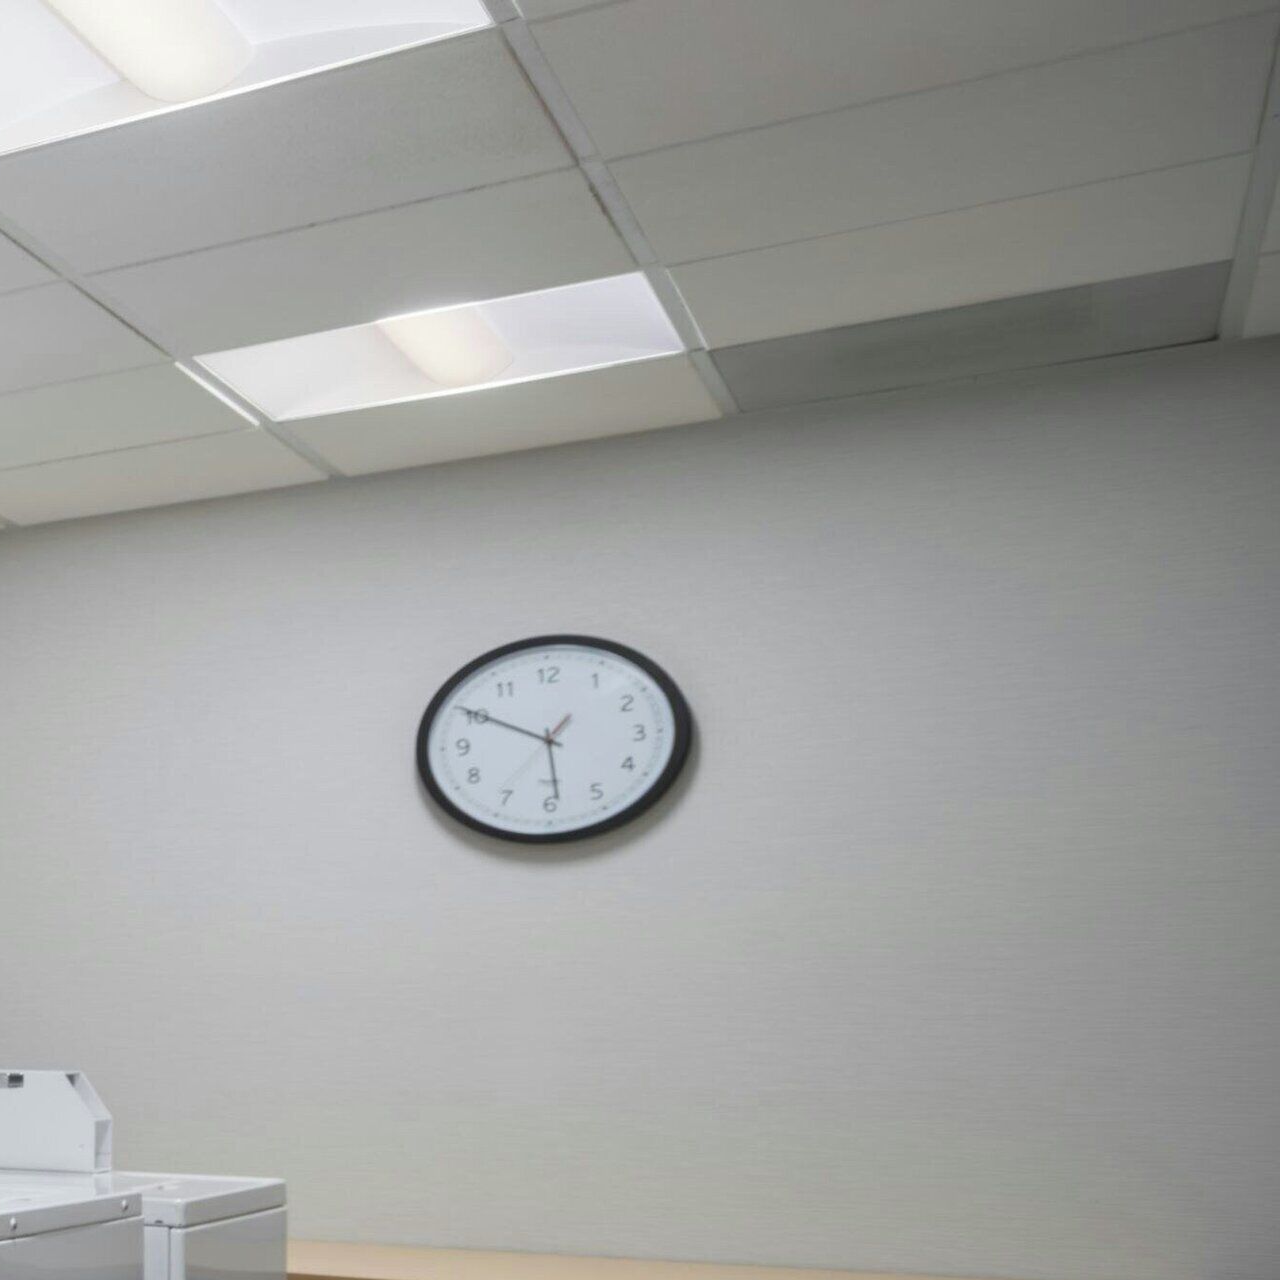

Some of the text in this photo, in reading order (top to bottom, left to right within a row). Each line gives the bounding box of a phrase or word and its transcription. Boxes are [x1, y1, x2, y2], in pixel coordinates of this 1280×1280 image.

[537, 667, 560, 684] 12
[591, 673, 600, 688] 1
[497, 682, 514, 697] 11
[620, 695, 634, 712] 2
[466, 709, 489, 725] 10
[633, 725, 646, 741] 3
[456, 738, 470, 756] 9
[621, 757, 634, 771] 4
[467, 767, 481, 784] 8
[500, 789, 513, 806] 7
[590, 783, 604, 800] 5
[543, 796, 557, 813] 6
